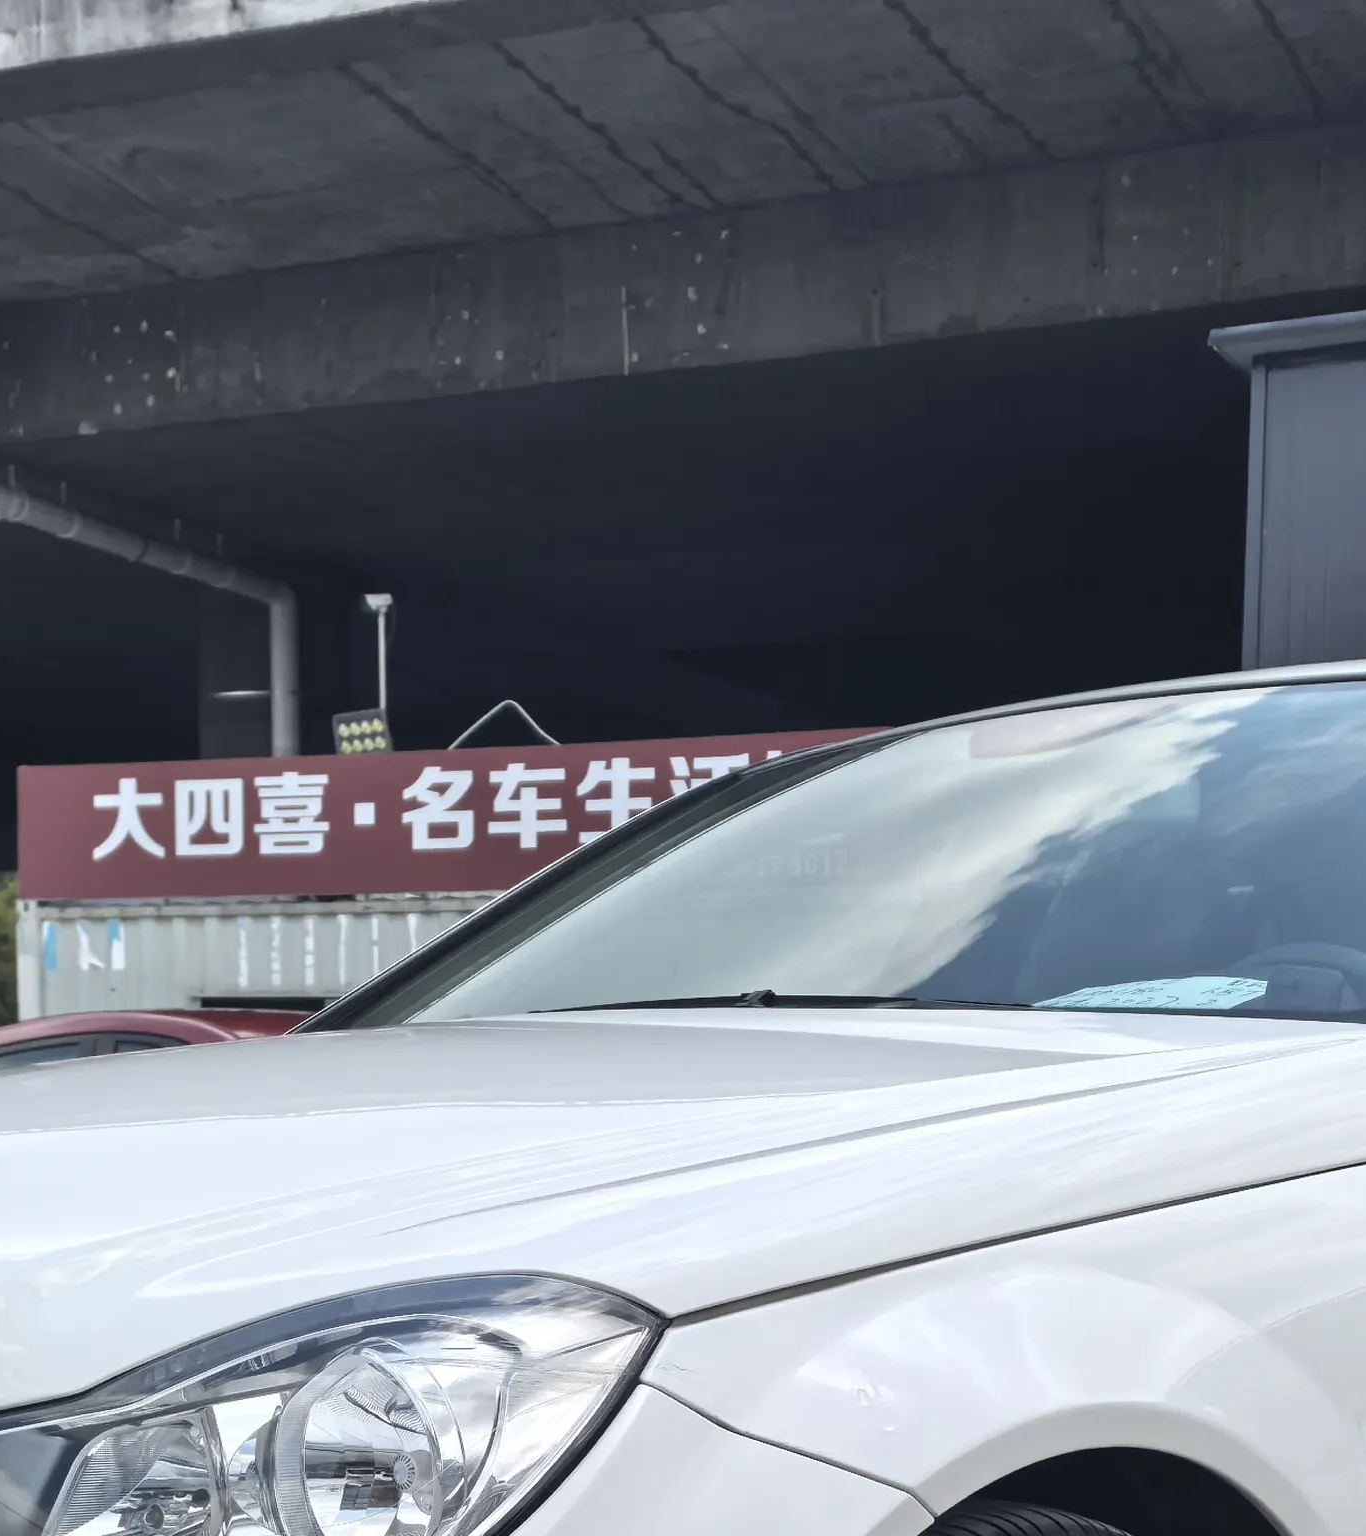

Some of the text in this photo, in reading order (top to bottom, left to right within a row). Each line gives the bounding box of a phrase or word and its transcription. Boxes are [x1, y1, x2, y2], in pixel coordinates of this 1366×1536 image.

[92, 750, 783, 862] 大四喜·名车生
